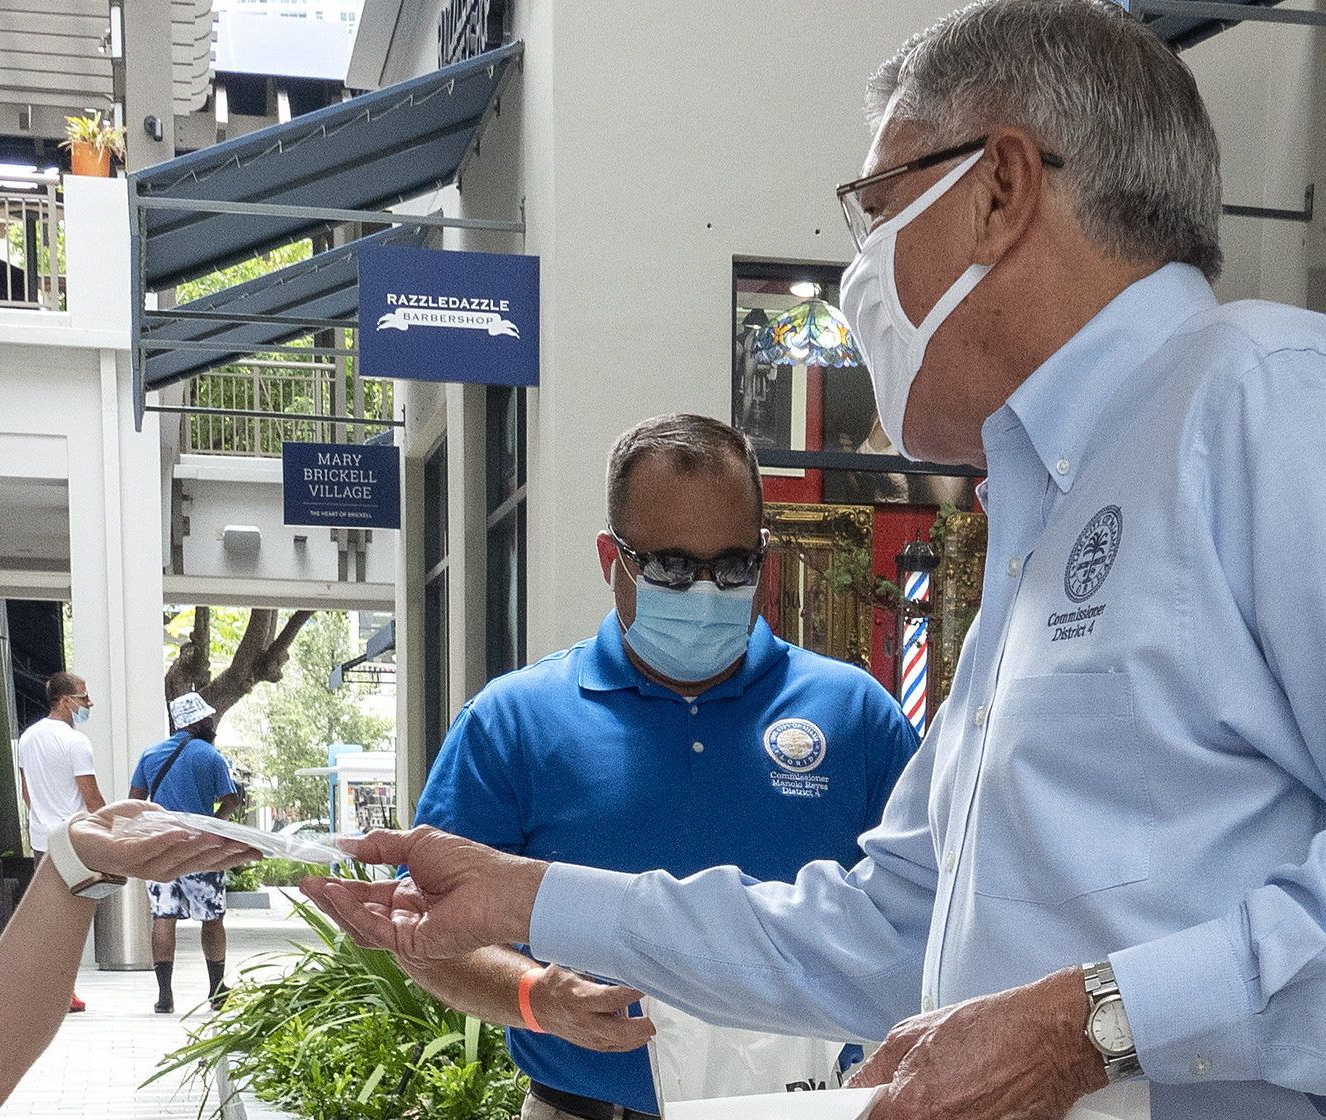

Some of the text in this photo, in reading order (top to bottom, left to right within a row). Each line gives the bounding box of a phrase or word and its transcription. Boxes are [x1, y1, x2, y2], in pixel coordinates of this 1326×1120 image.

[386, 293, 510, 312] RAZZLEDAZZLE
[403, 312, 494, 325] BARBERSHOP
[317, 452, 362, 466] MARY
[303, 467, 377, 483] BRICKELL
[308, 484, 372, 499] VILLAGE
[1047, 604, 1106, 627] Commissioner
[1052, 619, 1095, 641] District 4
